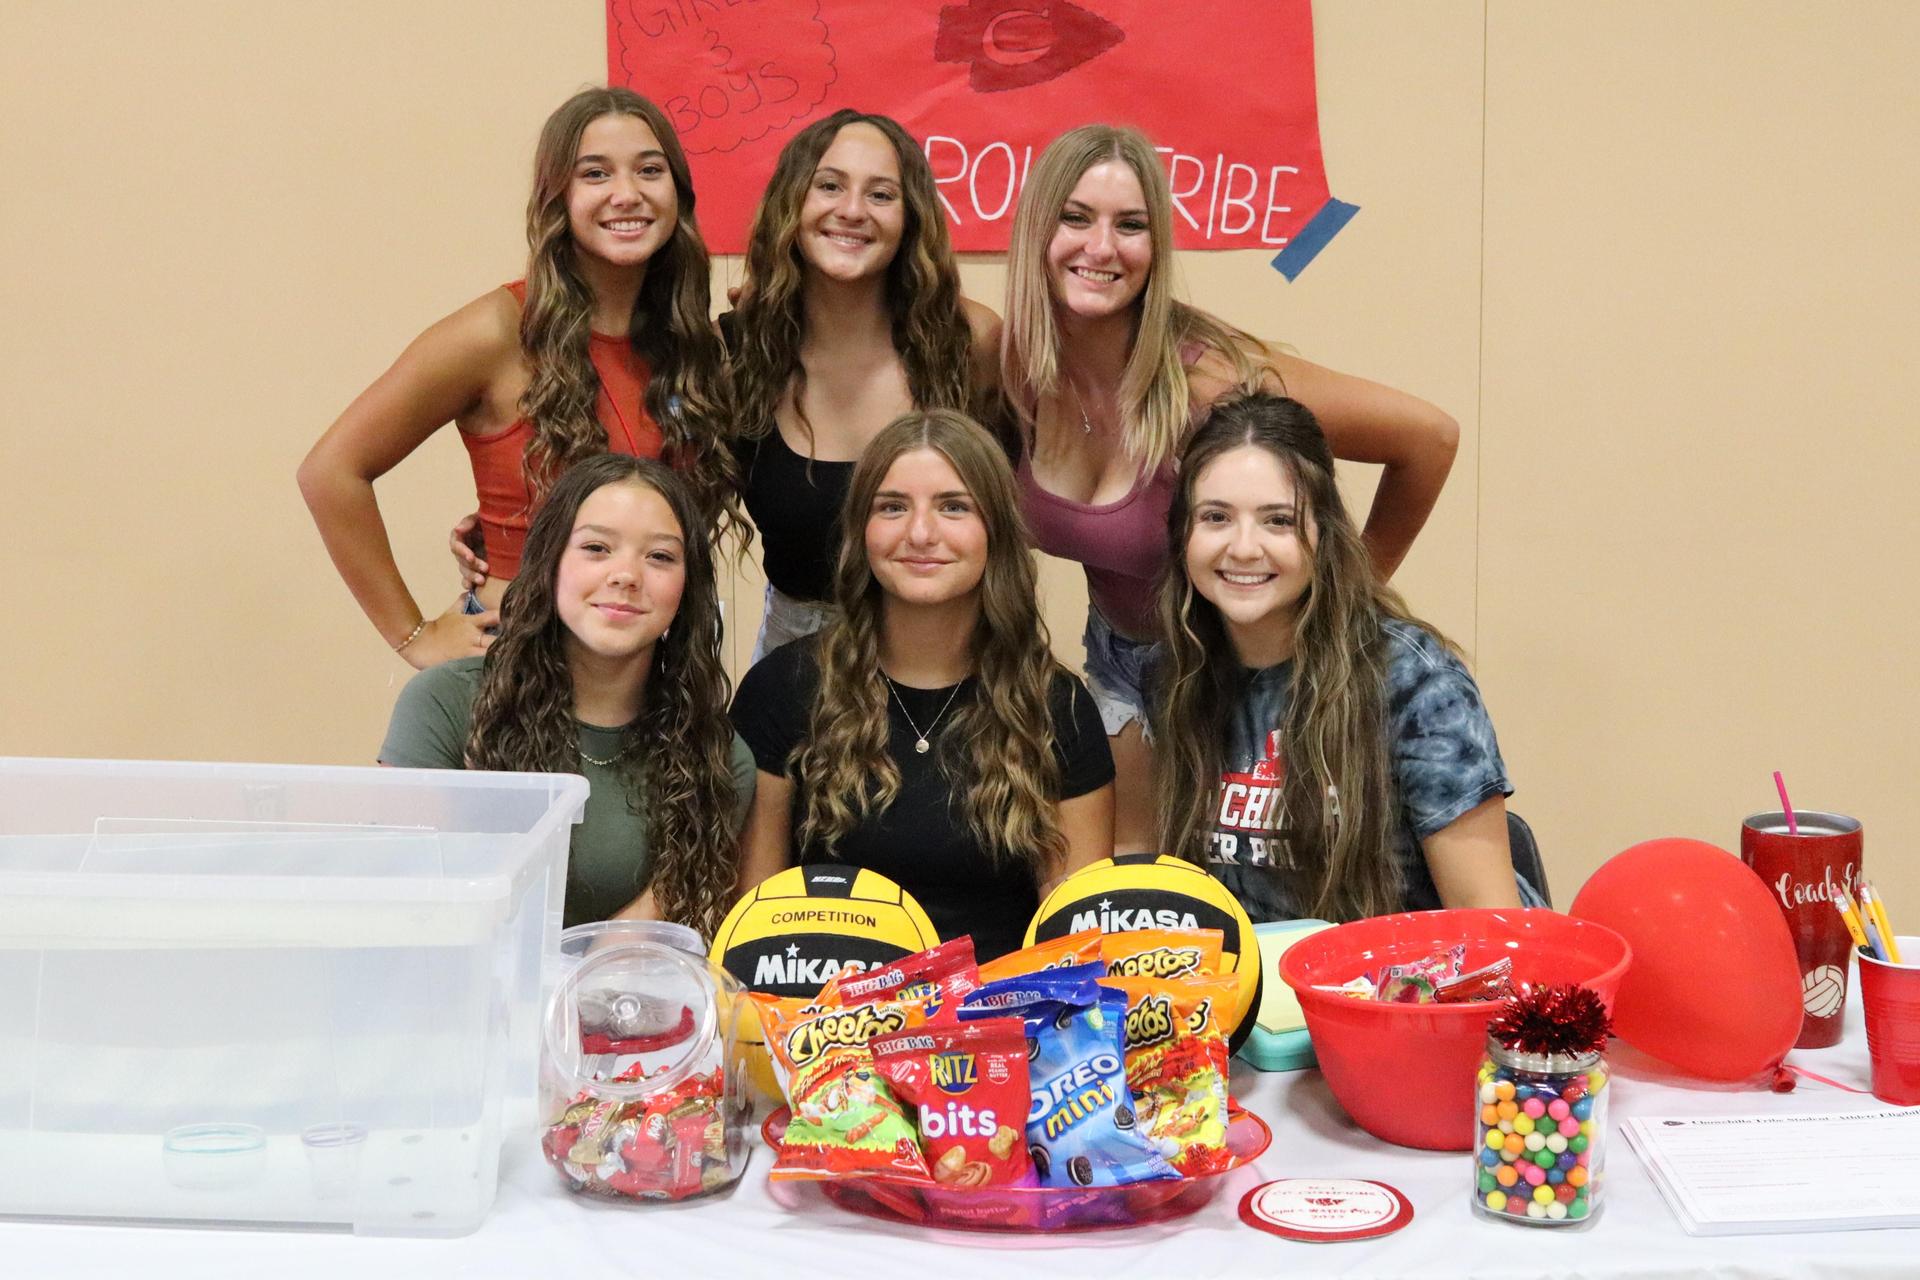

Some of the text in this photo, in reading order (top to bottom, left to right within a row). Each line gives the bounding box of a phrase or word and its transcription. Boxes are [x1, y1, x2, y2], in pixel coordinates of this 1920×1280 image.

[665, 61, 799, 134] BOYS
[1775, 865, 1836, 910] Coach
[771, 911, 876, 928] COMPETITION
[850, 970, 904, 998] BIG BAG
[986, 993, 1015, 1008] BIG
[1016, 990, 1041, 1003] BAG
[790, 1004, 905, 1064] Cheetos
[877, 1035, 935, 1056] BIG BAG
[929, 1053, 978, 1087] RITZ
[1027, 1054, 1120, 1123] OREO
[920, 1102, 999, 1139] bits
[1046, 1079, 1113, 1138] mini
